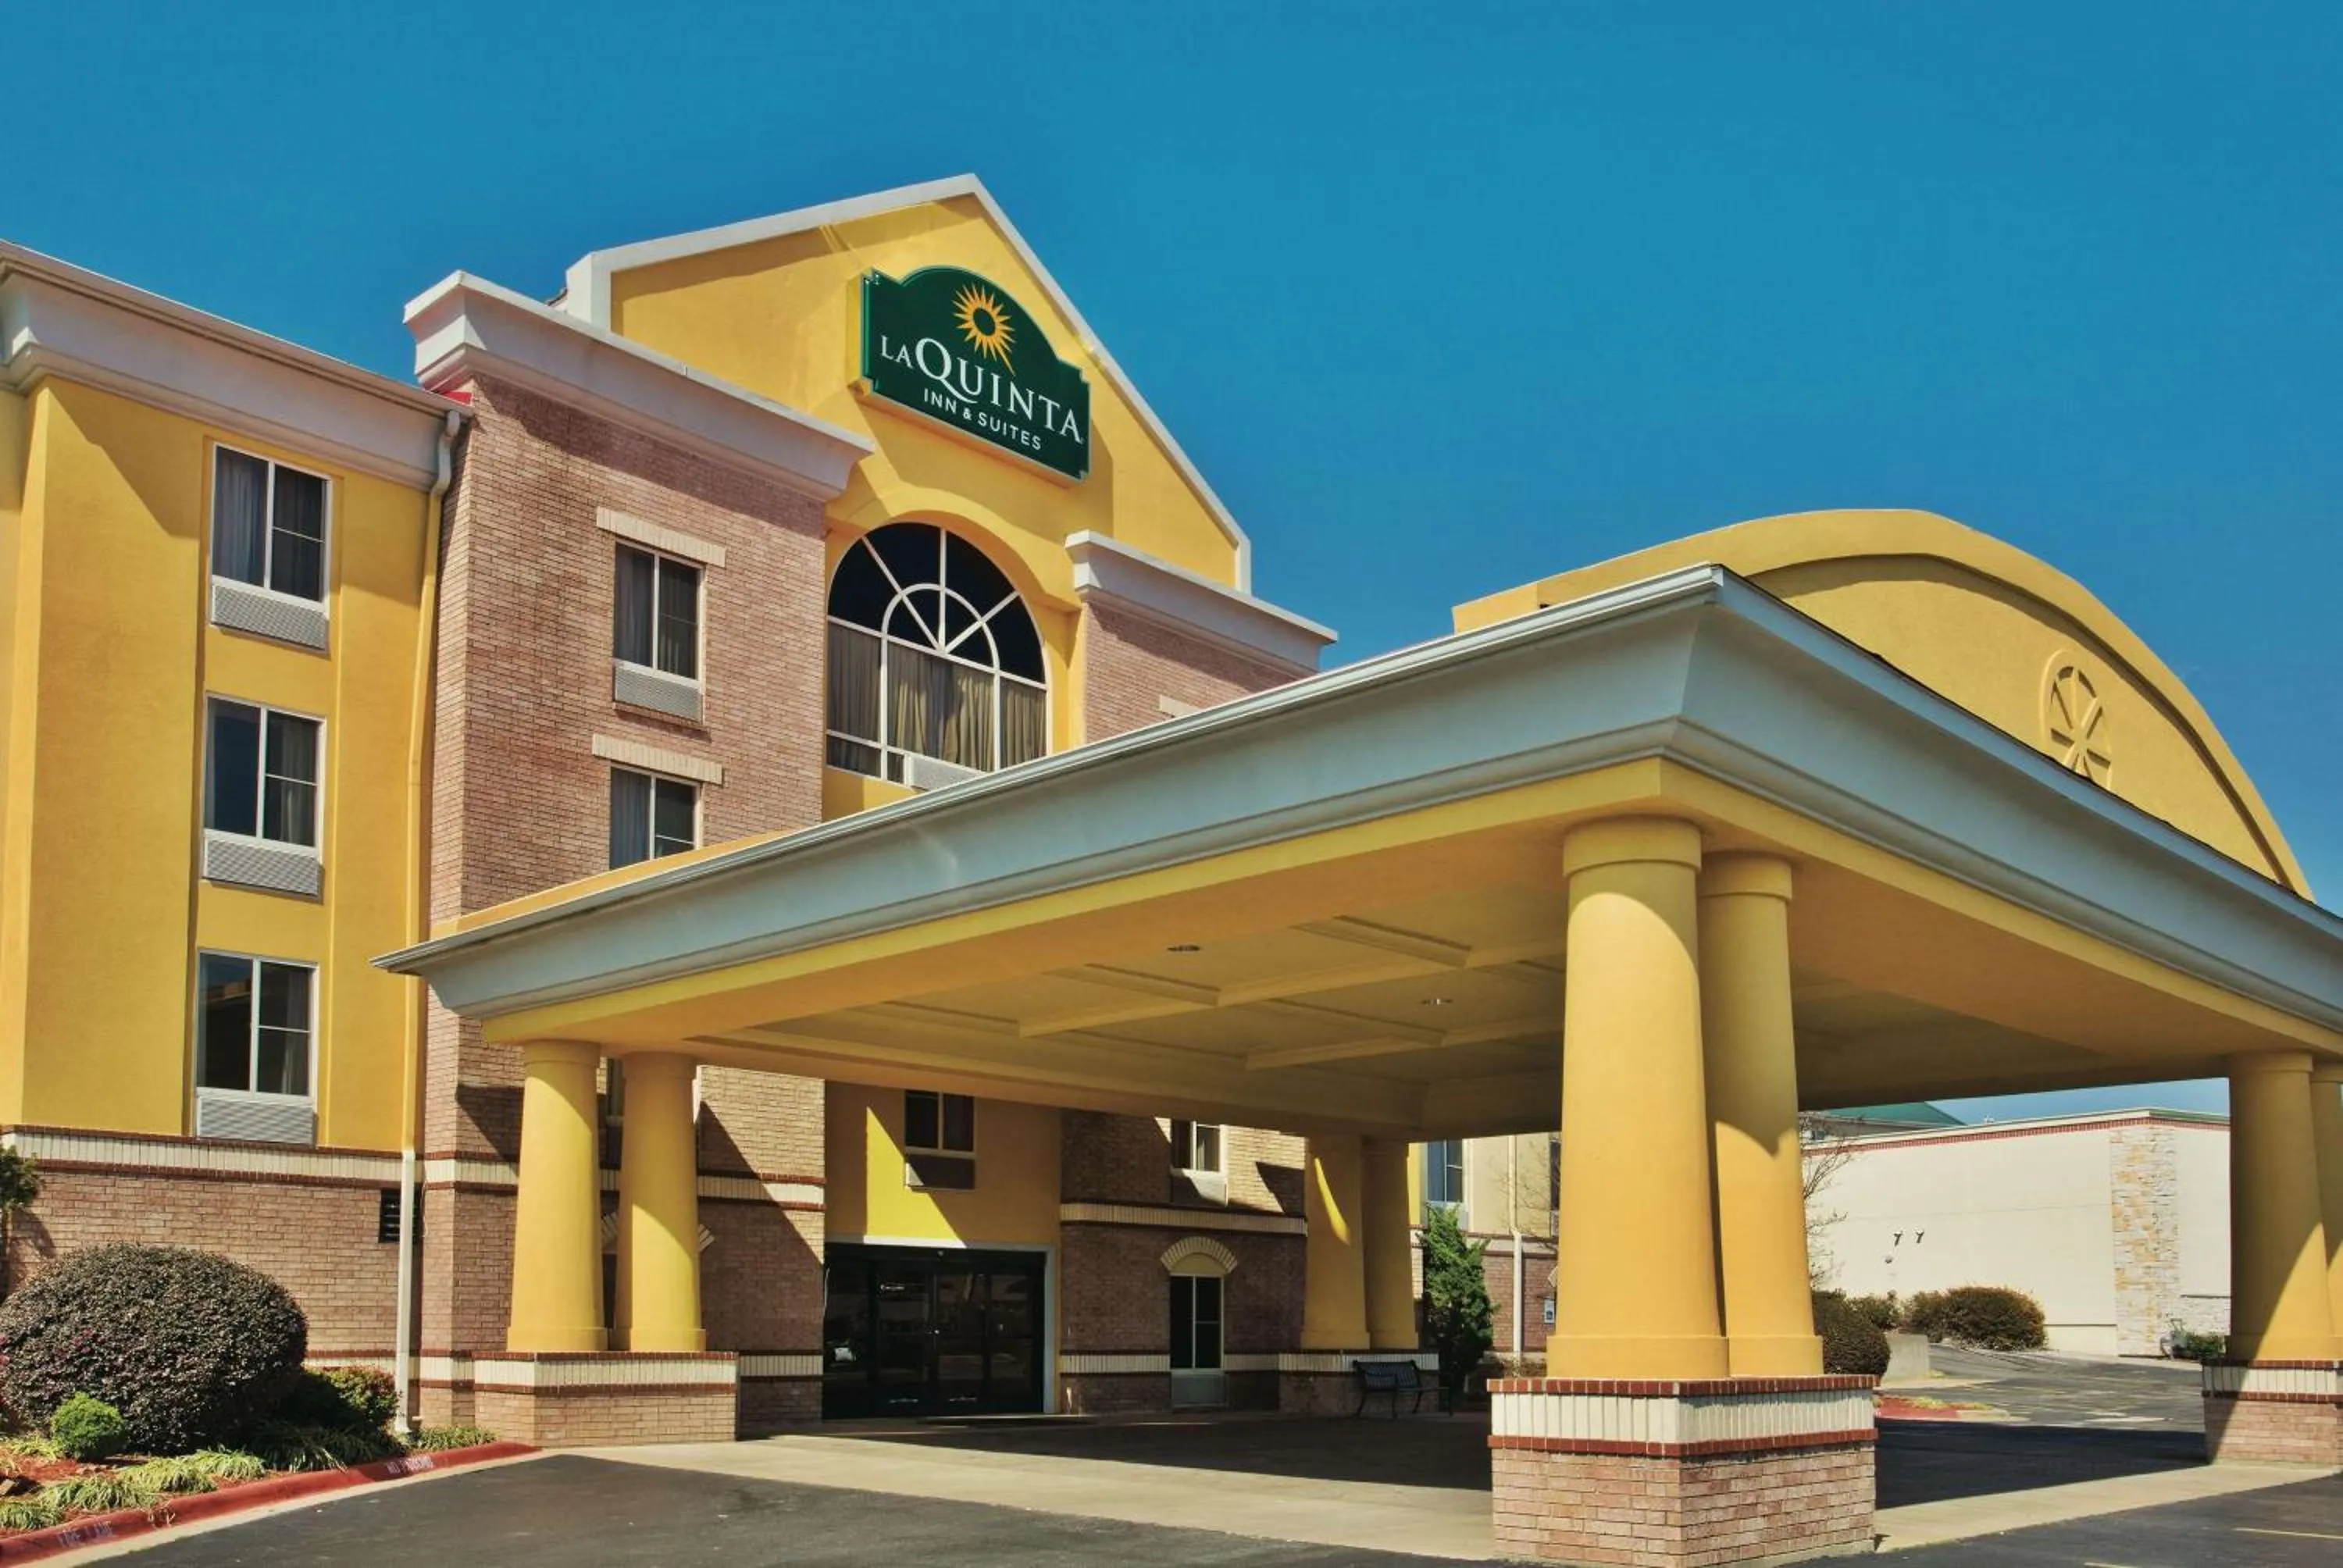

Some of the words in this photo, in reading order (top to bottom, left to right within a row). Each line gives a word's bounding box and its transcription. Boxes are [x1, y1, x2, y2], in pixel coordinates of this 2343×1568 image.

[881, 334, 914, 369] LA
[915, 337, 1084, 444] QUINTA
[924, 388, 957, 414] INN
[962, 407, 972, 421] &
[978, 412, 1042, 451] SUITES
